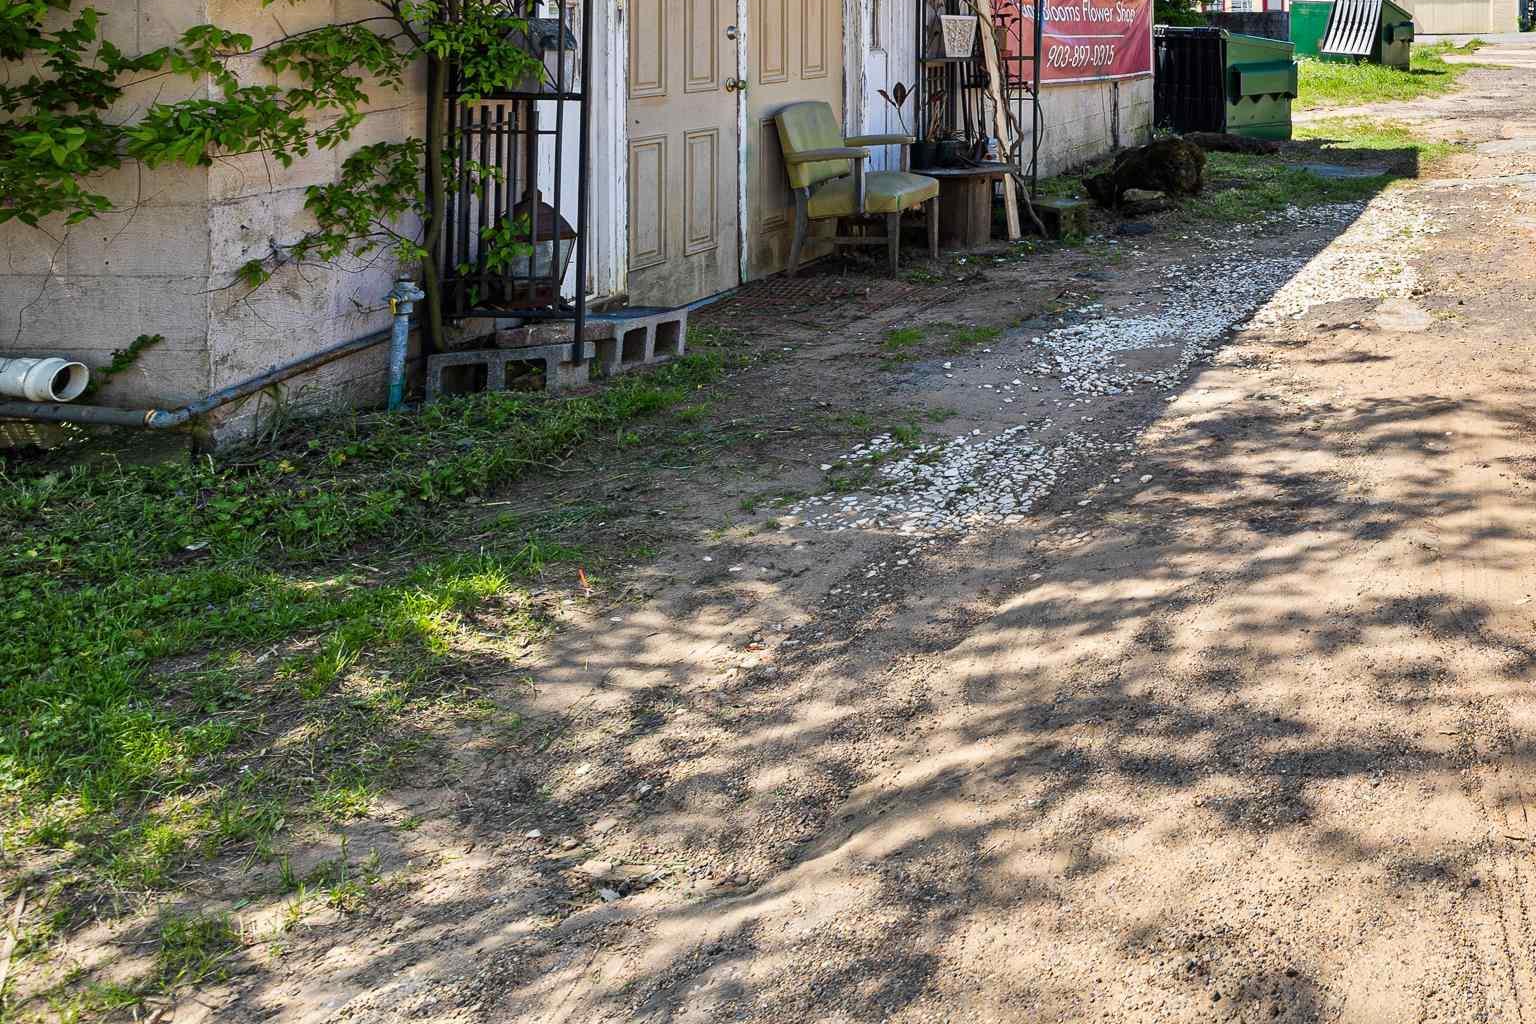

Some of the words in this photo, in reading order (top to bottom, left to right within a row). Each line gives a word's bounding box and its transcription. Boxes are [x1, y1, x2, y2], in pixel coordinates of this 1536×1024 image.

[1082, 0, 1113, 22] Flower
[1115, 0, 1136, 24] Shop
[1047, 44, 1115, 68] 903-897-0315
